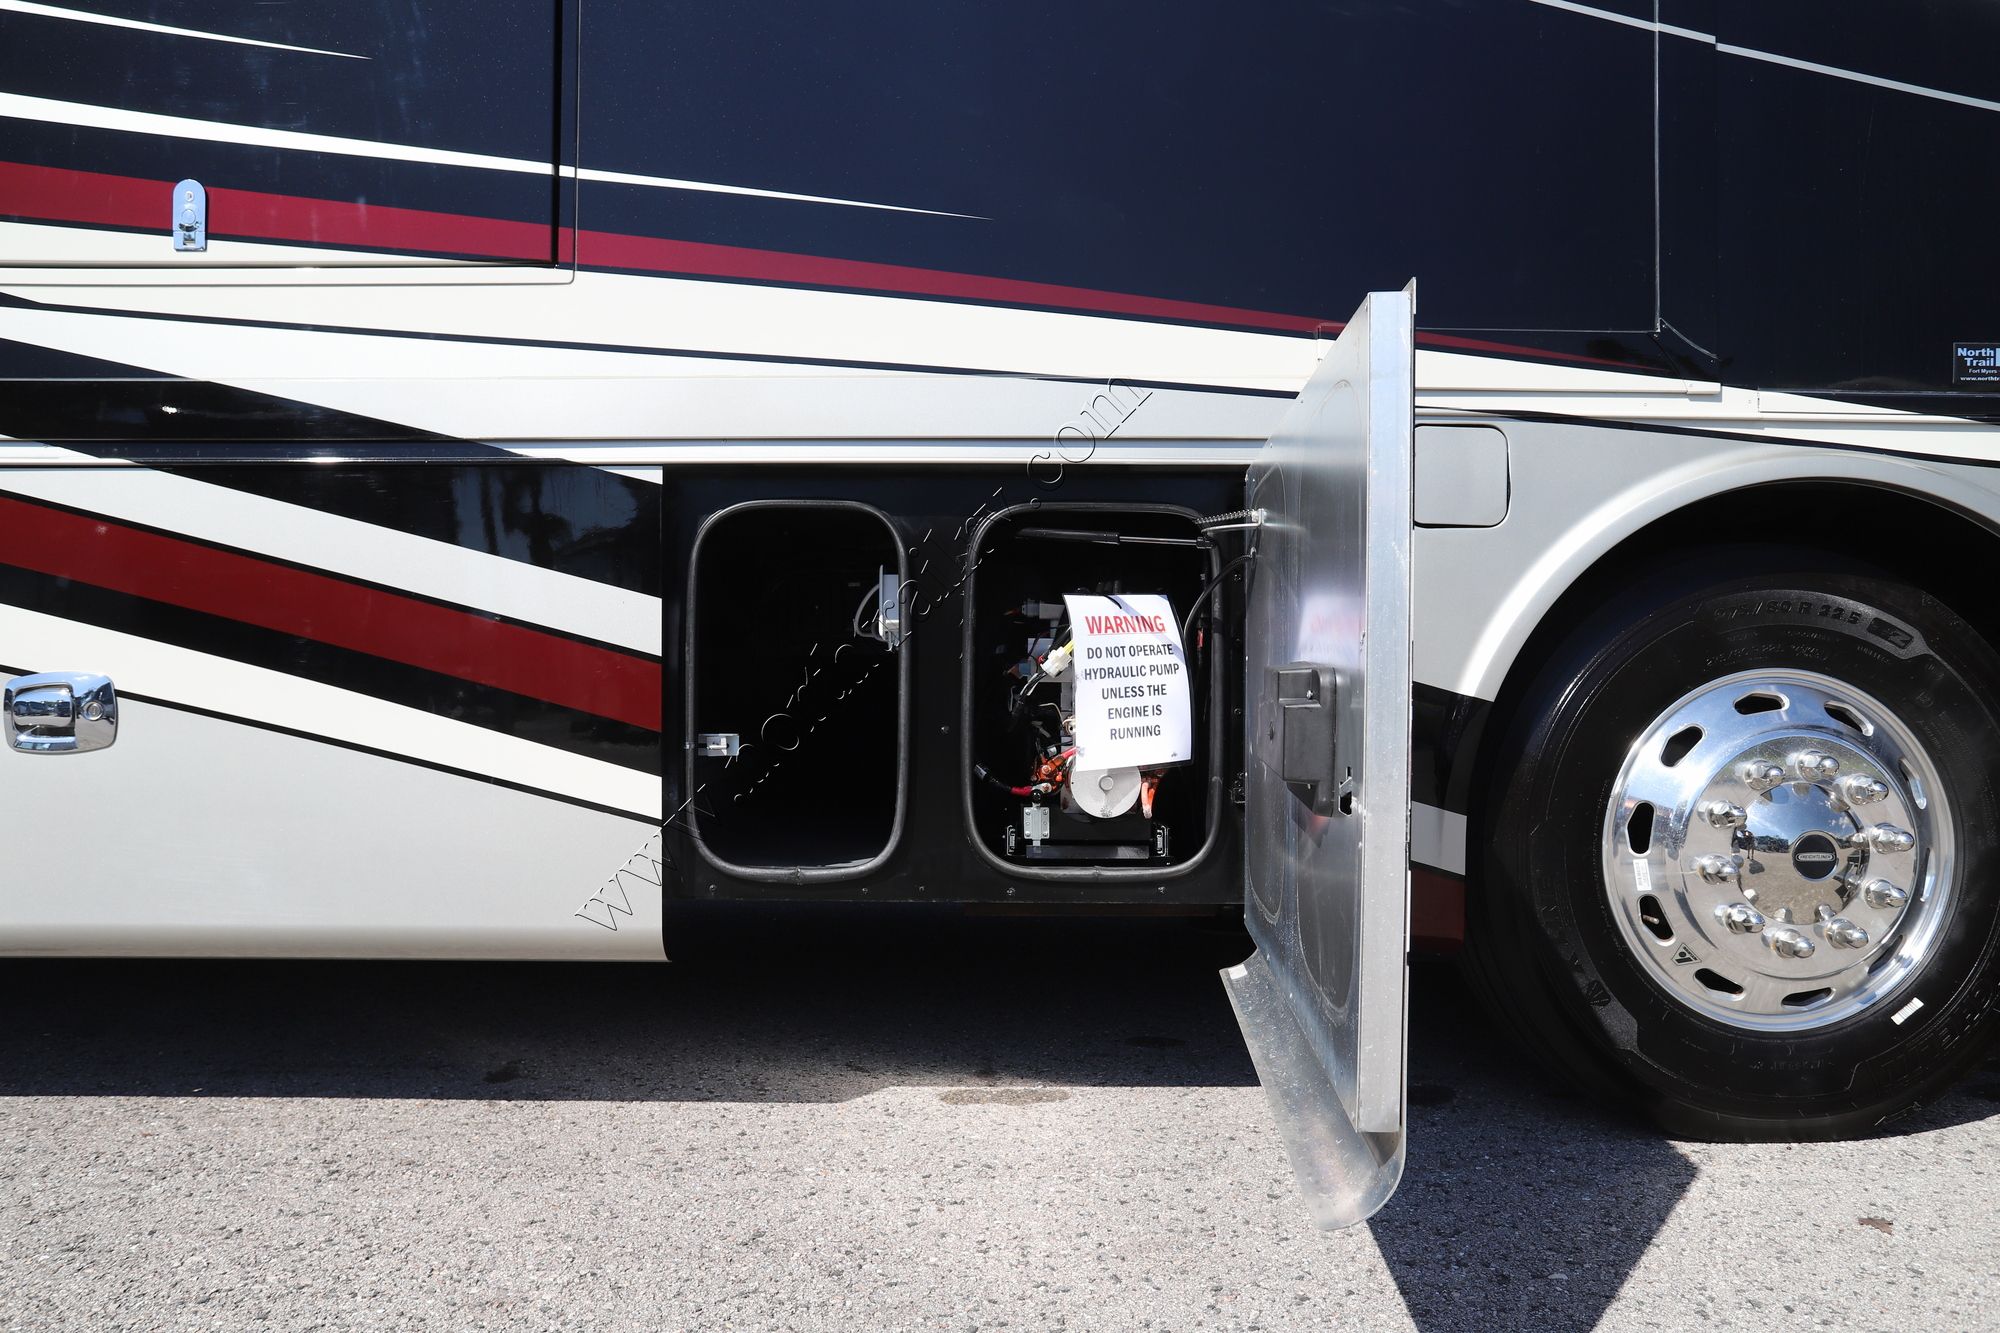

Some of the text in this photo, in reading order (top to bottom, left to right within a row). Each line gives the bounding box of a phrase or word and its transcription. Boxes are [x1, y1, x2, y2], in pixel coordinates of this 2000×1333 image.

[1957, 347, 1994, 356] North
[1964, 357, 1994, 366] Trail
[1085, 615, 1166, 634] WARNING
[1087, 643, 1174, 659] DO NOT OPERATE
[1084, 663, 1180, 681] HYDRAULIC PUMP
[1101, 683, 1167, 700] UNLESS THE
[1107, 704, 1162, 720] ENGINE IS
[1110, 724, 1161, 740] RUNNING
